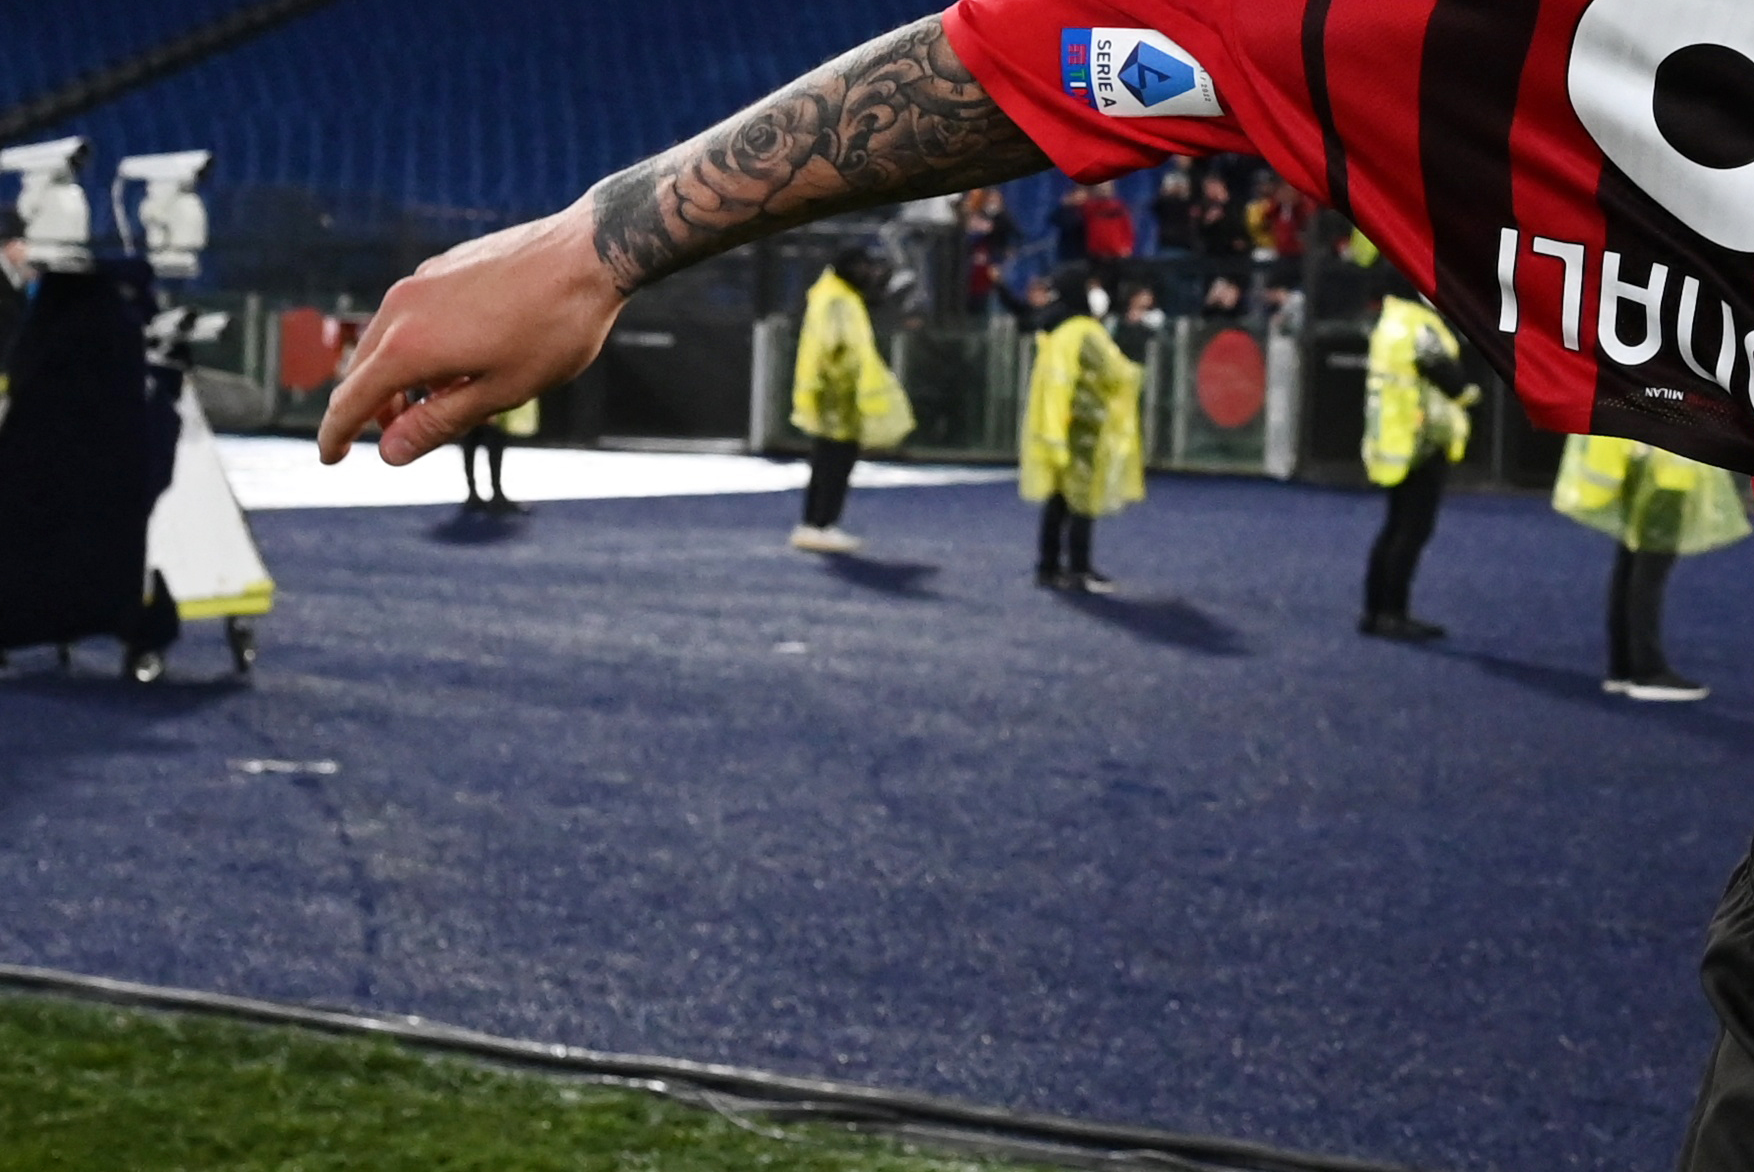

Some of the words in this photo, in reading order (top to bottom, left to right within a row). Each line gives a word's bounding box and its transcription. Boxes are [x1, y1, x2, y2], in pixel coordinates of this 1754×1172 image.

[1097, 39, 1114, 93] SERIE
[1101, 96, 1117, 109] A
[1645, 386, 1684, 401] MILAN
